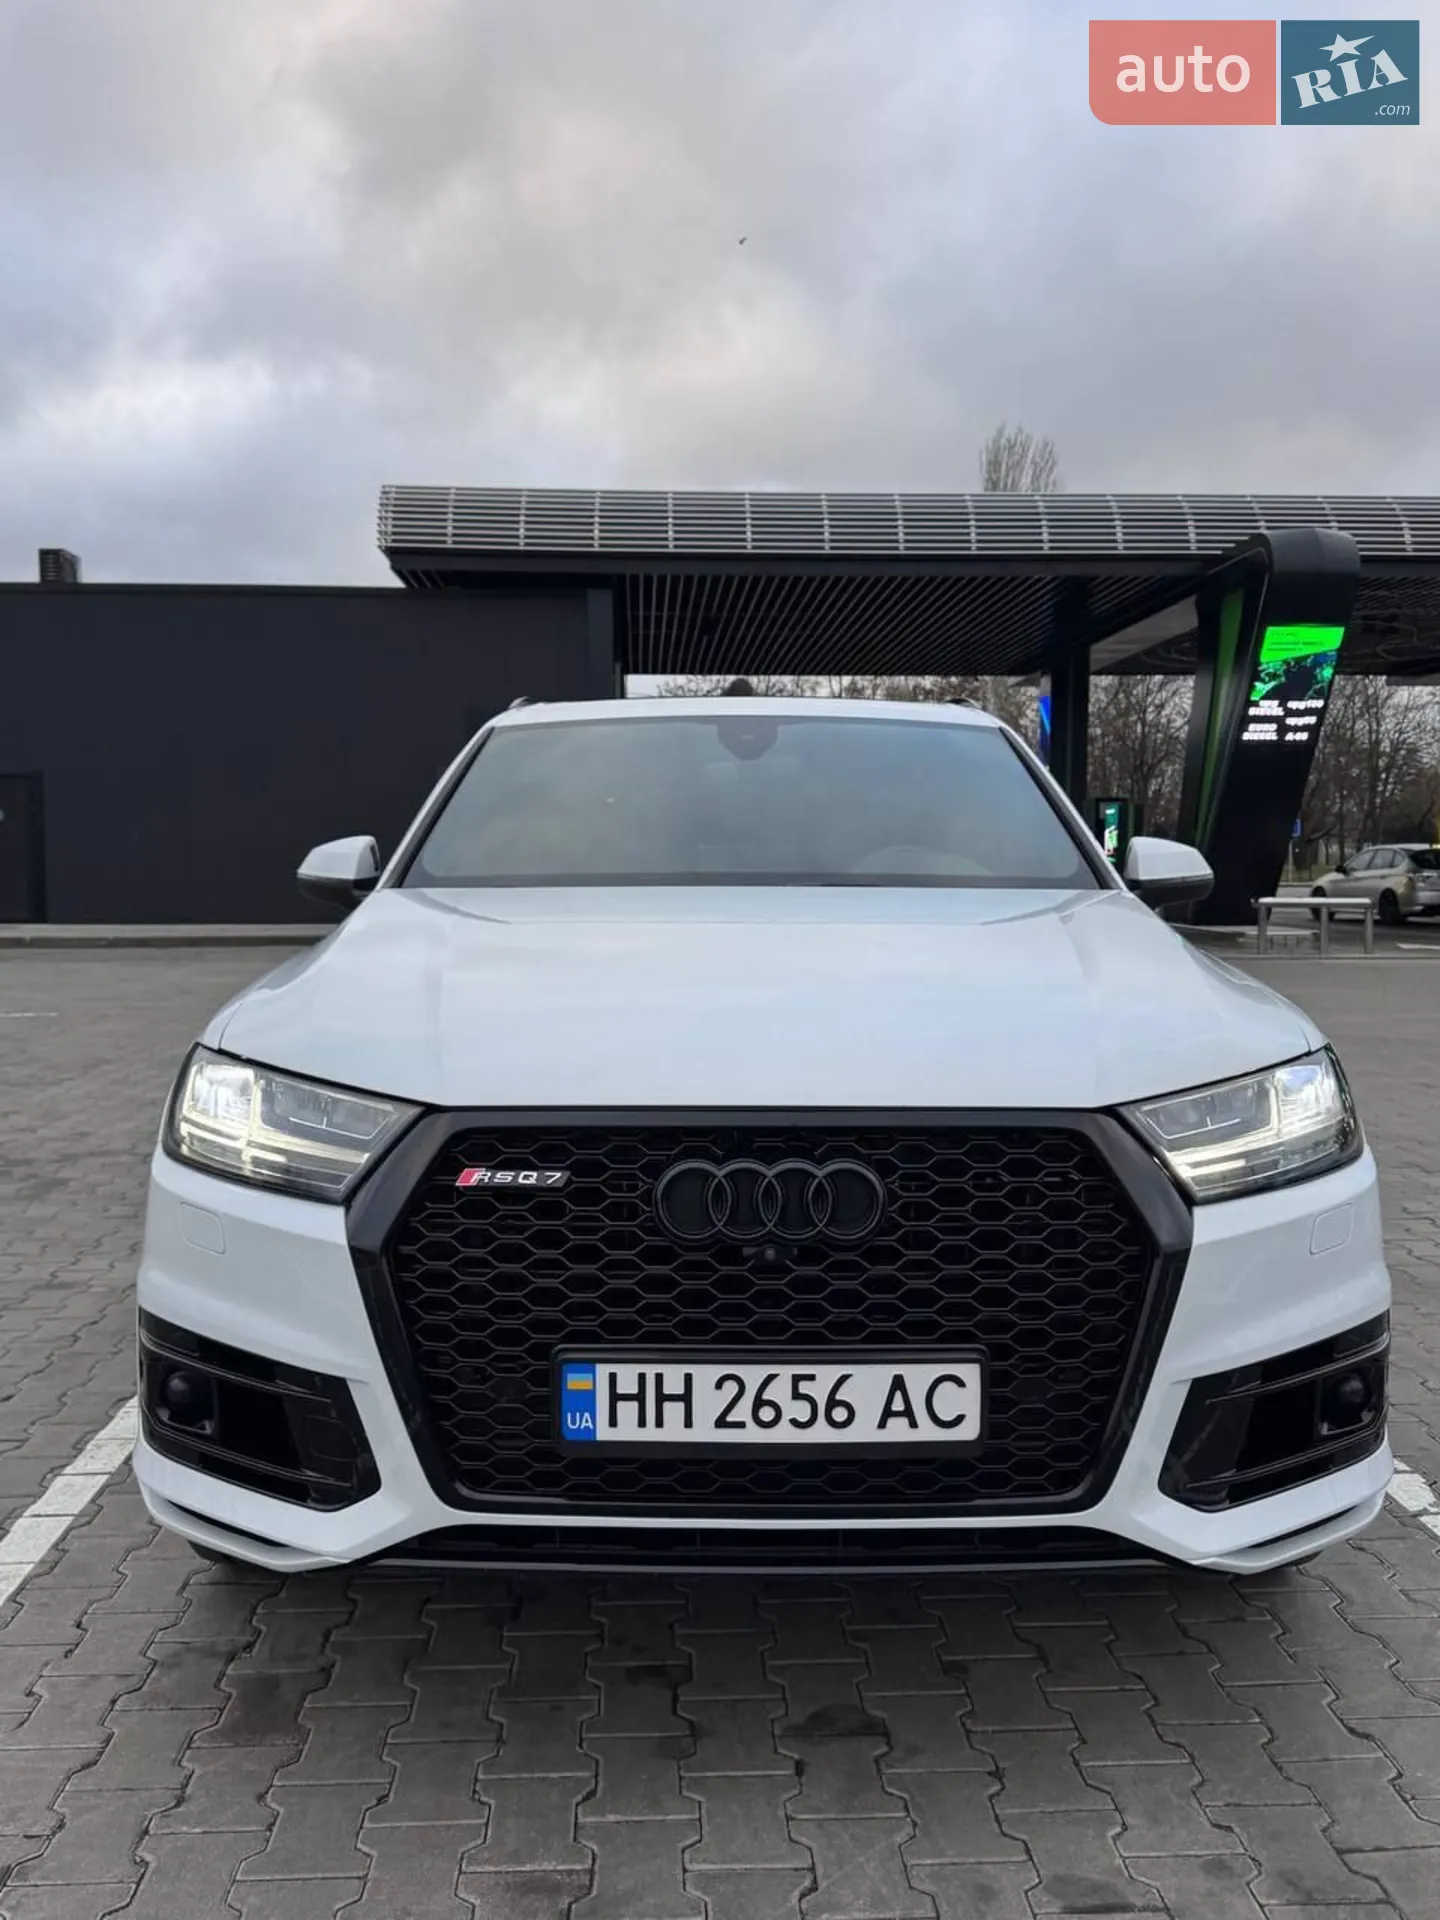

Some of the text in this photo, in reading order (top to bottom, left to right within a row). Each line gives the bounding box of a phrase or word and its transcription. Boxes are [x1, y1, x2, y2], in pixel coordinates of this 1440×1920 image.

[608, 1371, 968, 1430] HH 2656 AC
[567, 1412, 594, 1430] UA
